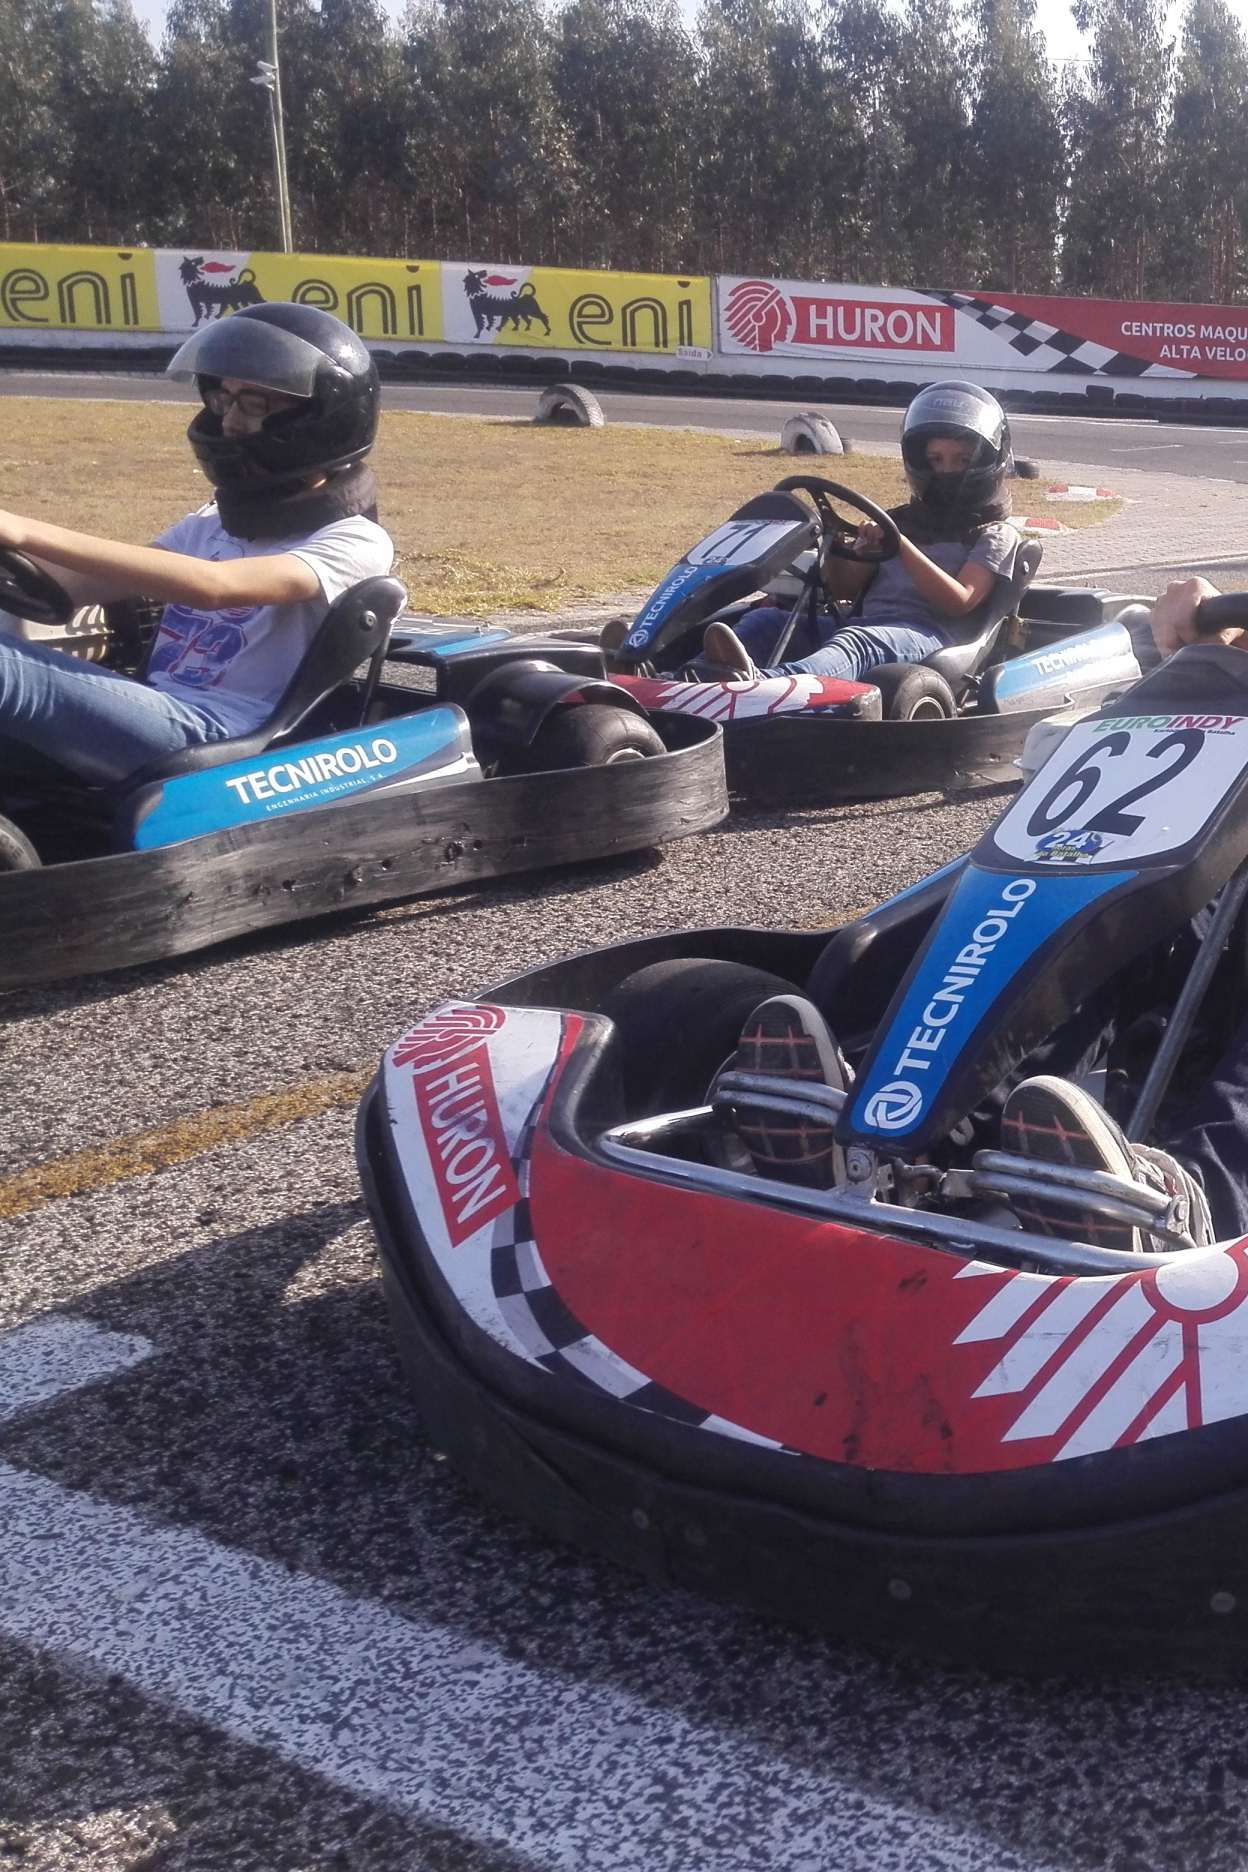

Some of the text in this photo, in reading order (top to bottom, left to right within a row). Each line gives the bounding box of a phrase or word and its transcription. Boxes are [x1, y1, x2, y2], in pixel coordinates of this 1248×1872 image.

[1, 253, 140, 326] eni
[292, 265, 425, 336] eni
[568, 280, 692, 348] eni
[808, 304, 942, 346] HURON
[1121, 321, 1196, 338] CENTROS
[1160, 344, 1201, 359] ALTA
[641, 566, 697, 628] TECNIROLO
[1092, 715, 1245, 732] EUROINDY
[225, 738, 398, 804] TECNIROLO
[266, 791, 319, 811] ENGENHARIA
[1025, 731, 1206, 837] 62
[1044, 831, 1091, 849] 24
[894, 878, 1037, 1074] TECNIROLO
[425, 1061, 506, 1224] HURON
